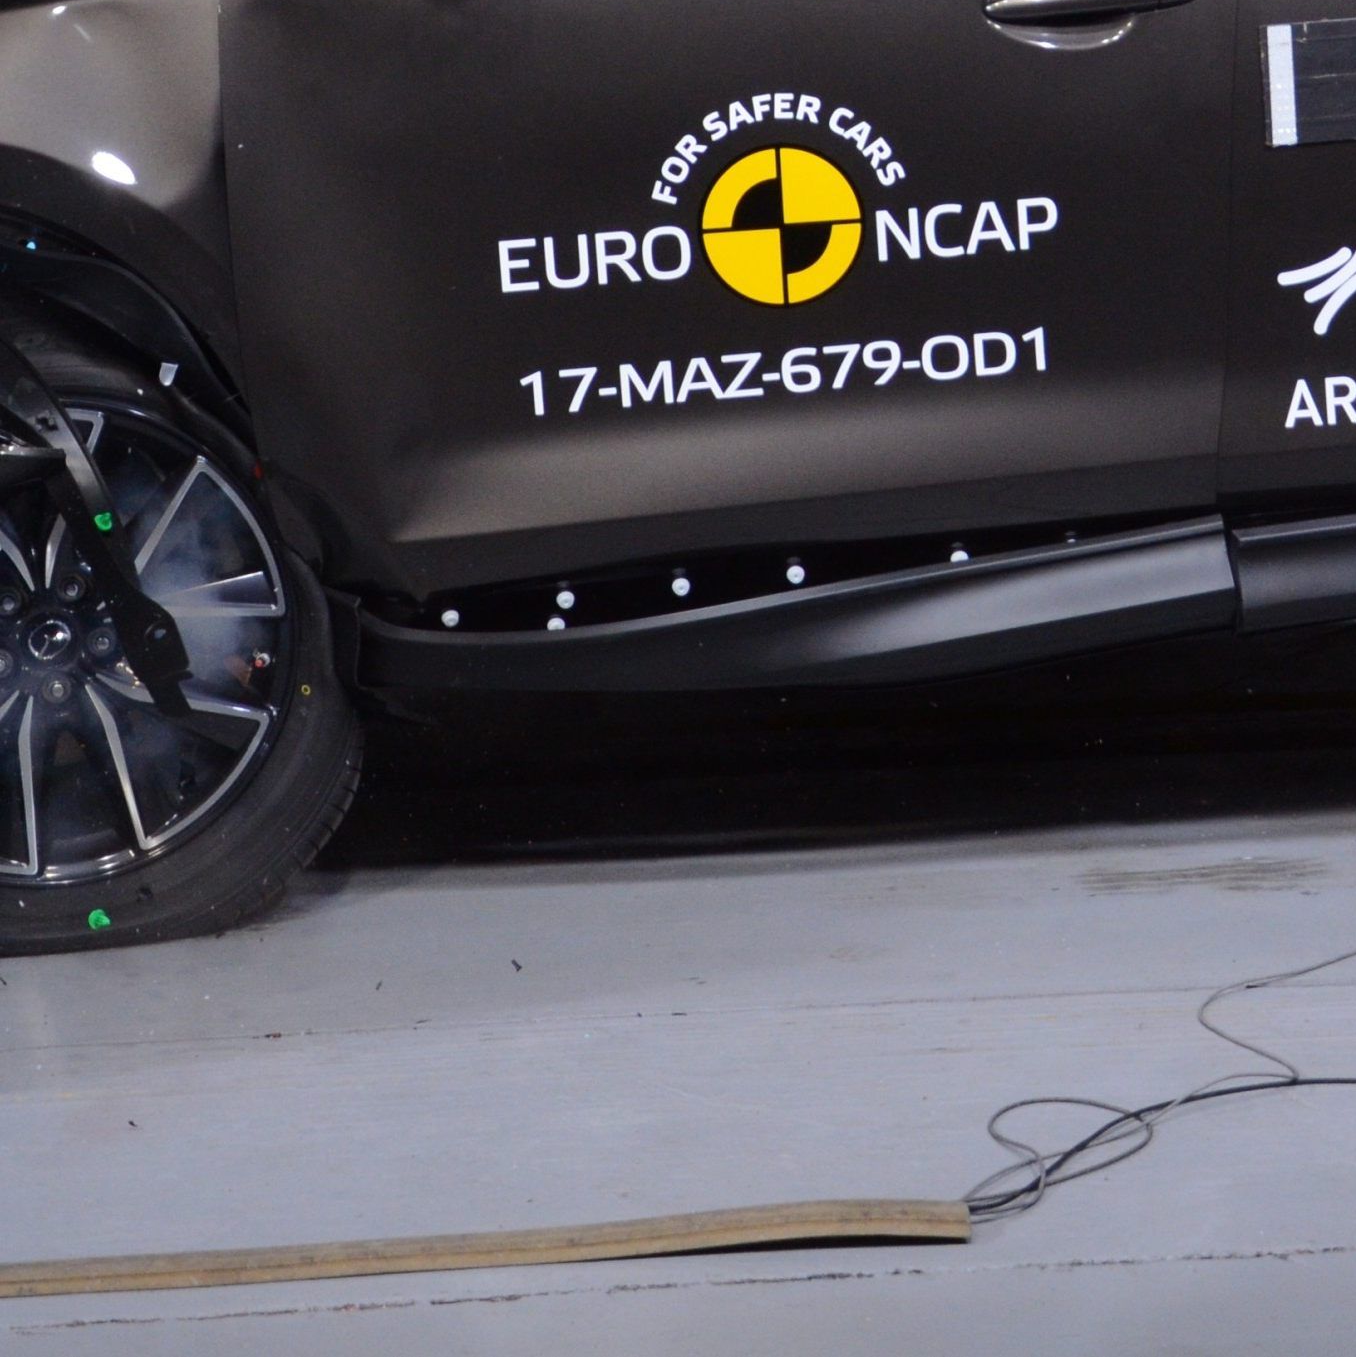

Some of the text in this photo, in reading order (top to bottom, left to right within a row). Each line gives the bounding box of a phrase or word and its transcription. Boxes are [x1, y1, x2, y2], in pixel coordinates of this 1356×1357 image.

[651, 92, 906, 205] FOR SAFER CARS
[498, 197, 1058, 293] EURO NCAP
[519, 326, 1046, 416] 17-MAZ-679-OD1
